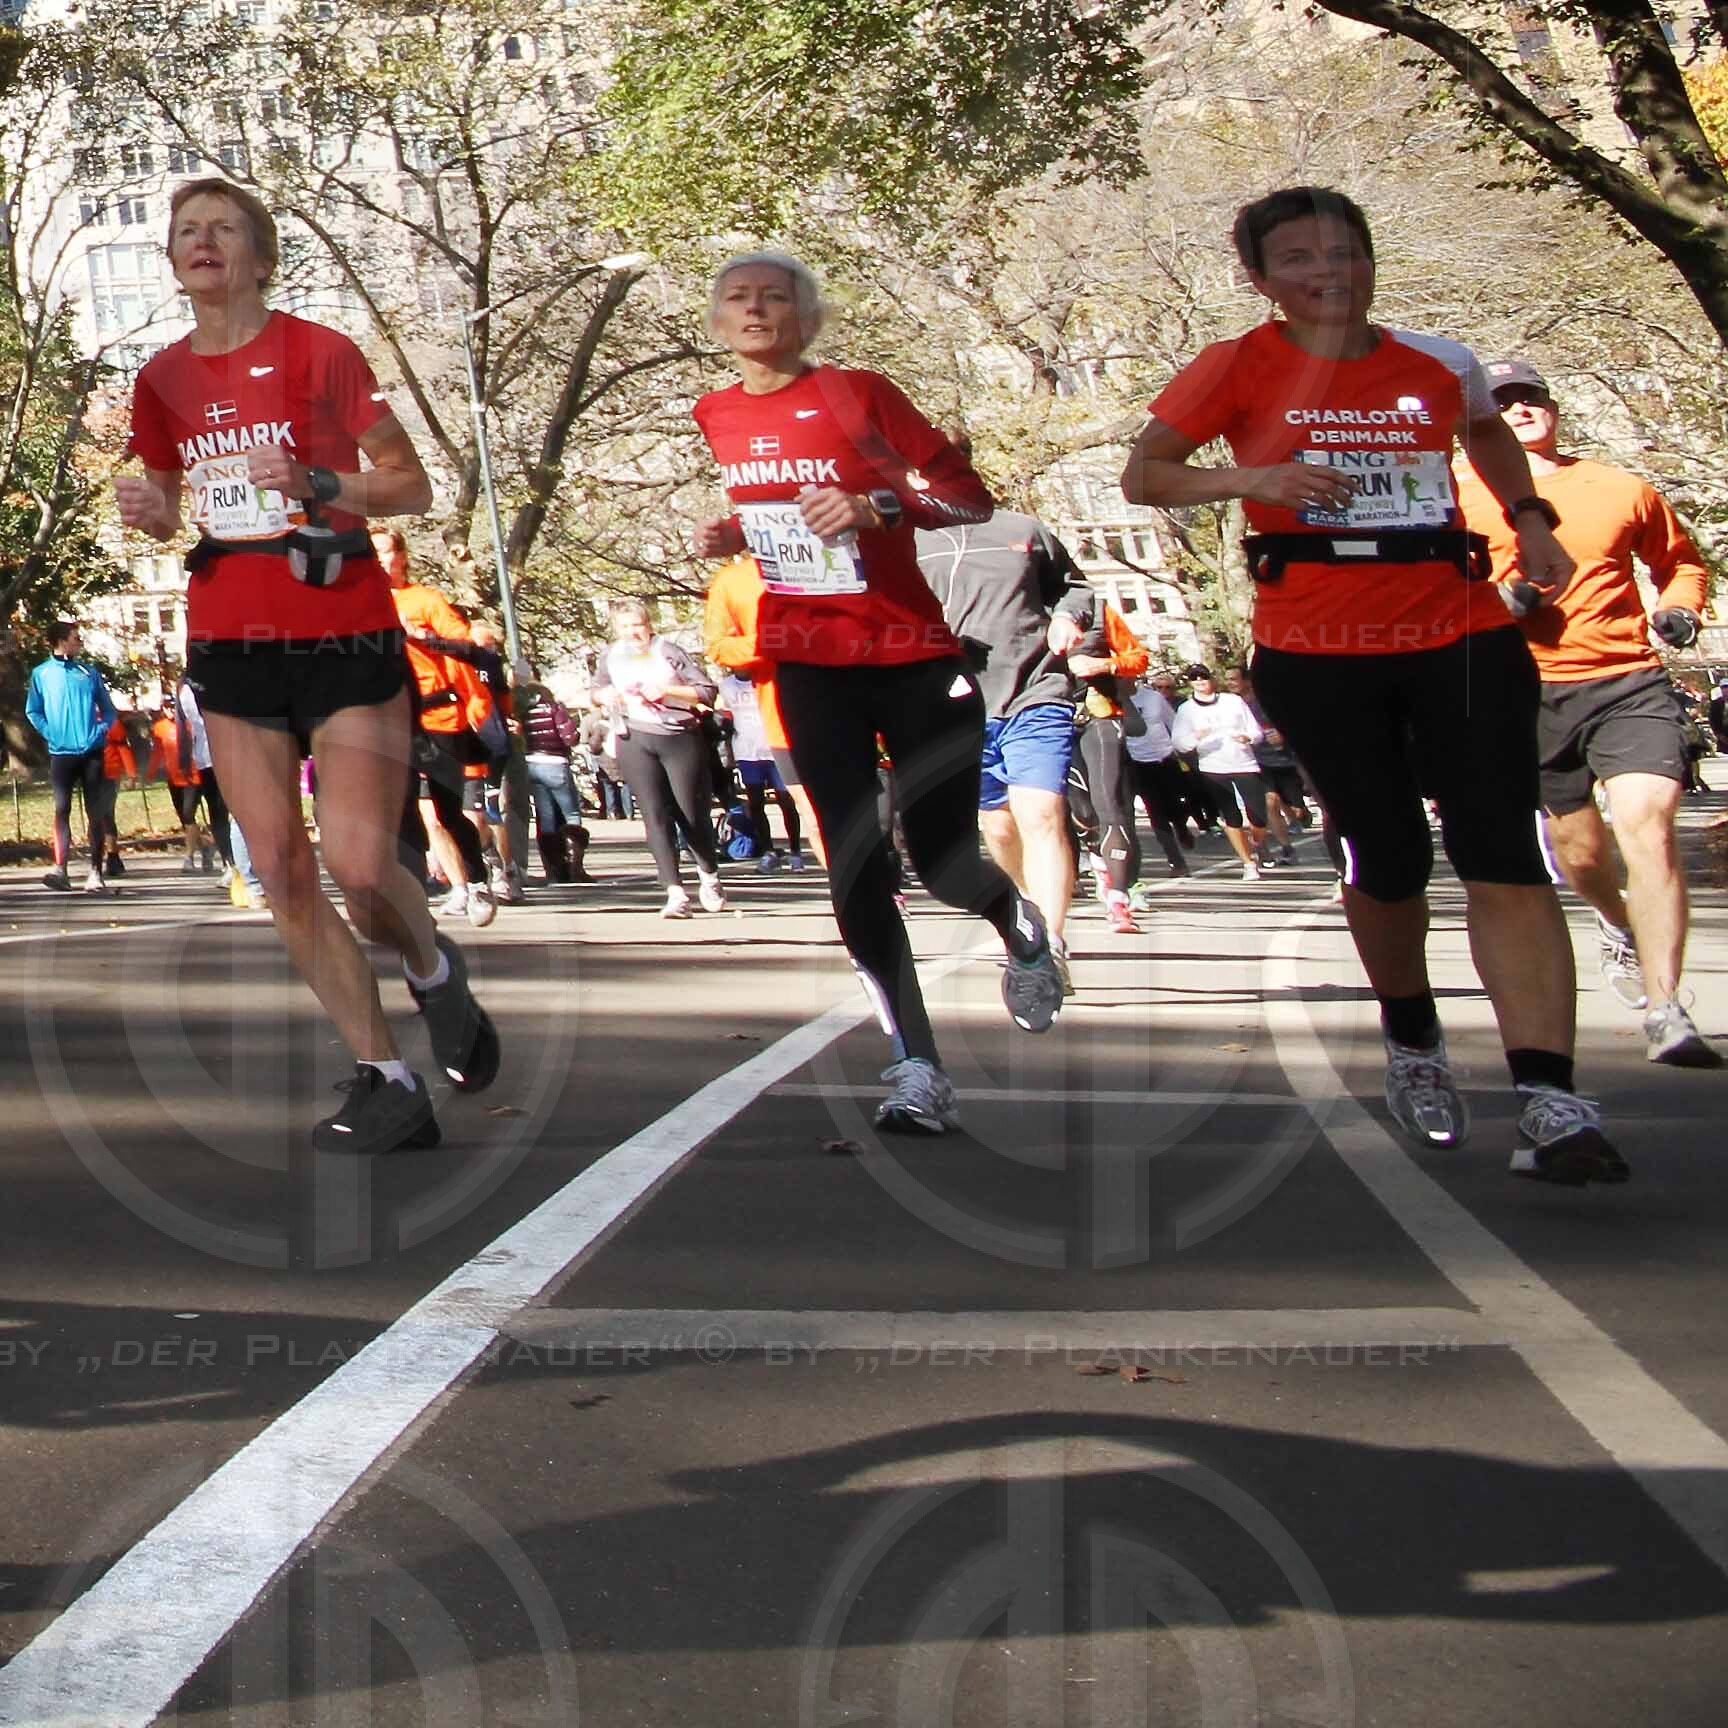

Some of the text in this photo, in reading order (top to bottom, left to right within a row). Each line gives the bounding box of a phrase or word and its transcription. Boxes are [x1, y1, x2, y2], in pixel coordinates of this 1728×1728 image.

[1284, 408, 1433, 425] CHARLOTTE
[1310, 430, 1417, 444] DENMARK
[1327, 451, 1386, 468] ING
[202, 463, 248, 482] ING
[212, 484, 247, 509] RUN
[753, 511, 798, 526] ING
[777, 543, 815, 565] RUN
